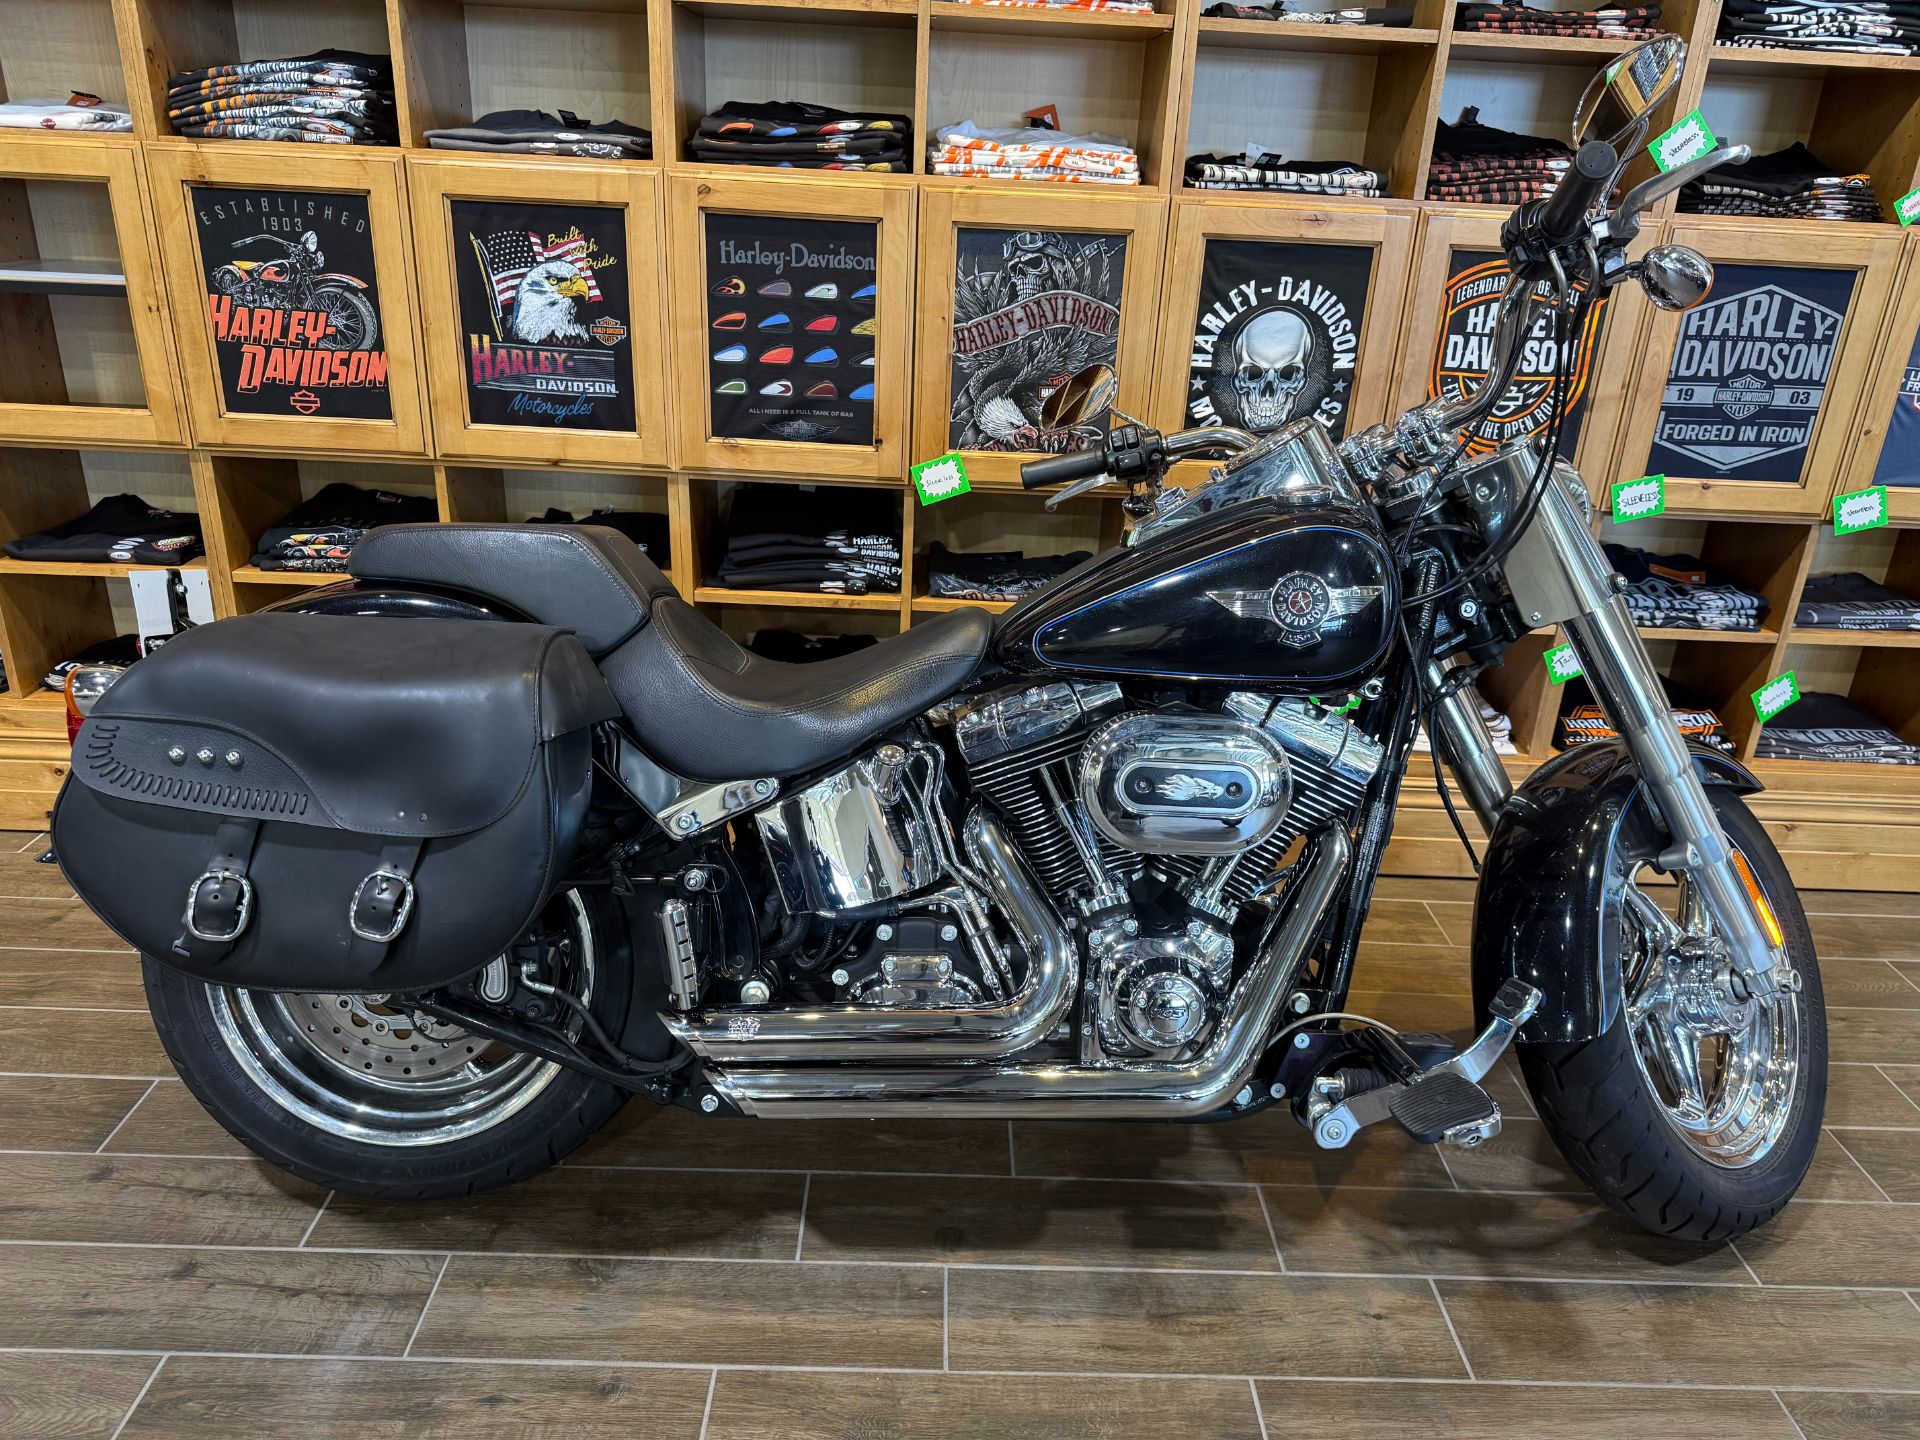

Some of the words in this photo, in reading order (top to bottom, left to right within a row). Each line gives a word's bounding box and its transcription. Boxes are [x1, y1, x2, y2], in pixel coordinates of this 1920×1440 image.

[200, 198, 365, 232] ESTABLISHED
[262, 217, 303, 232] 1903
[547, 226, 582, 247] Built
[569, 238, 599, 256] with
[583, 254, 617, 273] Pride
[720, 240, 875, 275] Harley-Davidson
[1456, 275, 1507, 304] LEGENDAR
[209, 294, 336, 348] HARLEY-
[954, 294, 1113, 355] HARLEY-DAVIDSON
[1687, 293, 1835, 339] HARLEY-
[237, 344, 387, 394] DAVIDSON
[470, 334, 574, 385] HARLEY-
[1678, 340, 1831, 383] DAVIDSON
[536, 378, 616, 394] DAVIDSON
[1732, 377, 1761, 389] MOTOR
[1675, 388, 1694, 401] 19
[1717, 389, 1771, 402] HARLEY-DAVIDSON
[1789, 391, 1810, 405] 03
[507, 393, 593, 424] Motorcycles
[1727, 404, 1755, 417] CYCLES
[1504, 417, 1535, 437] OPEN
[1662, 424, 1734, 442] FORGED
[1738, 425, 1756, 442] IN
[1760, 426, 1805, 444] IRON
[1278, 577, 1324, 598] HARLEY
[1275, 602, 1326, 627] DAVIDSON
